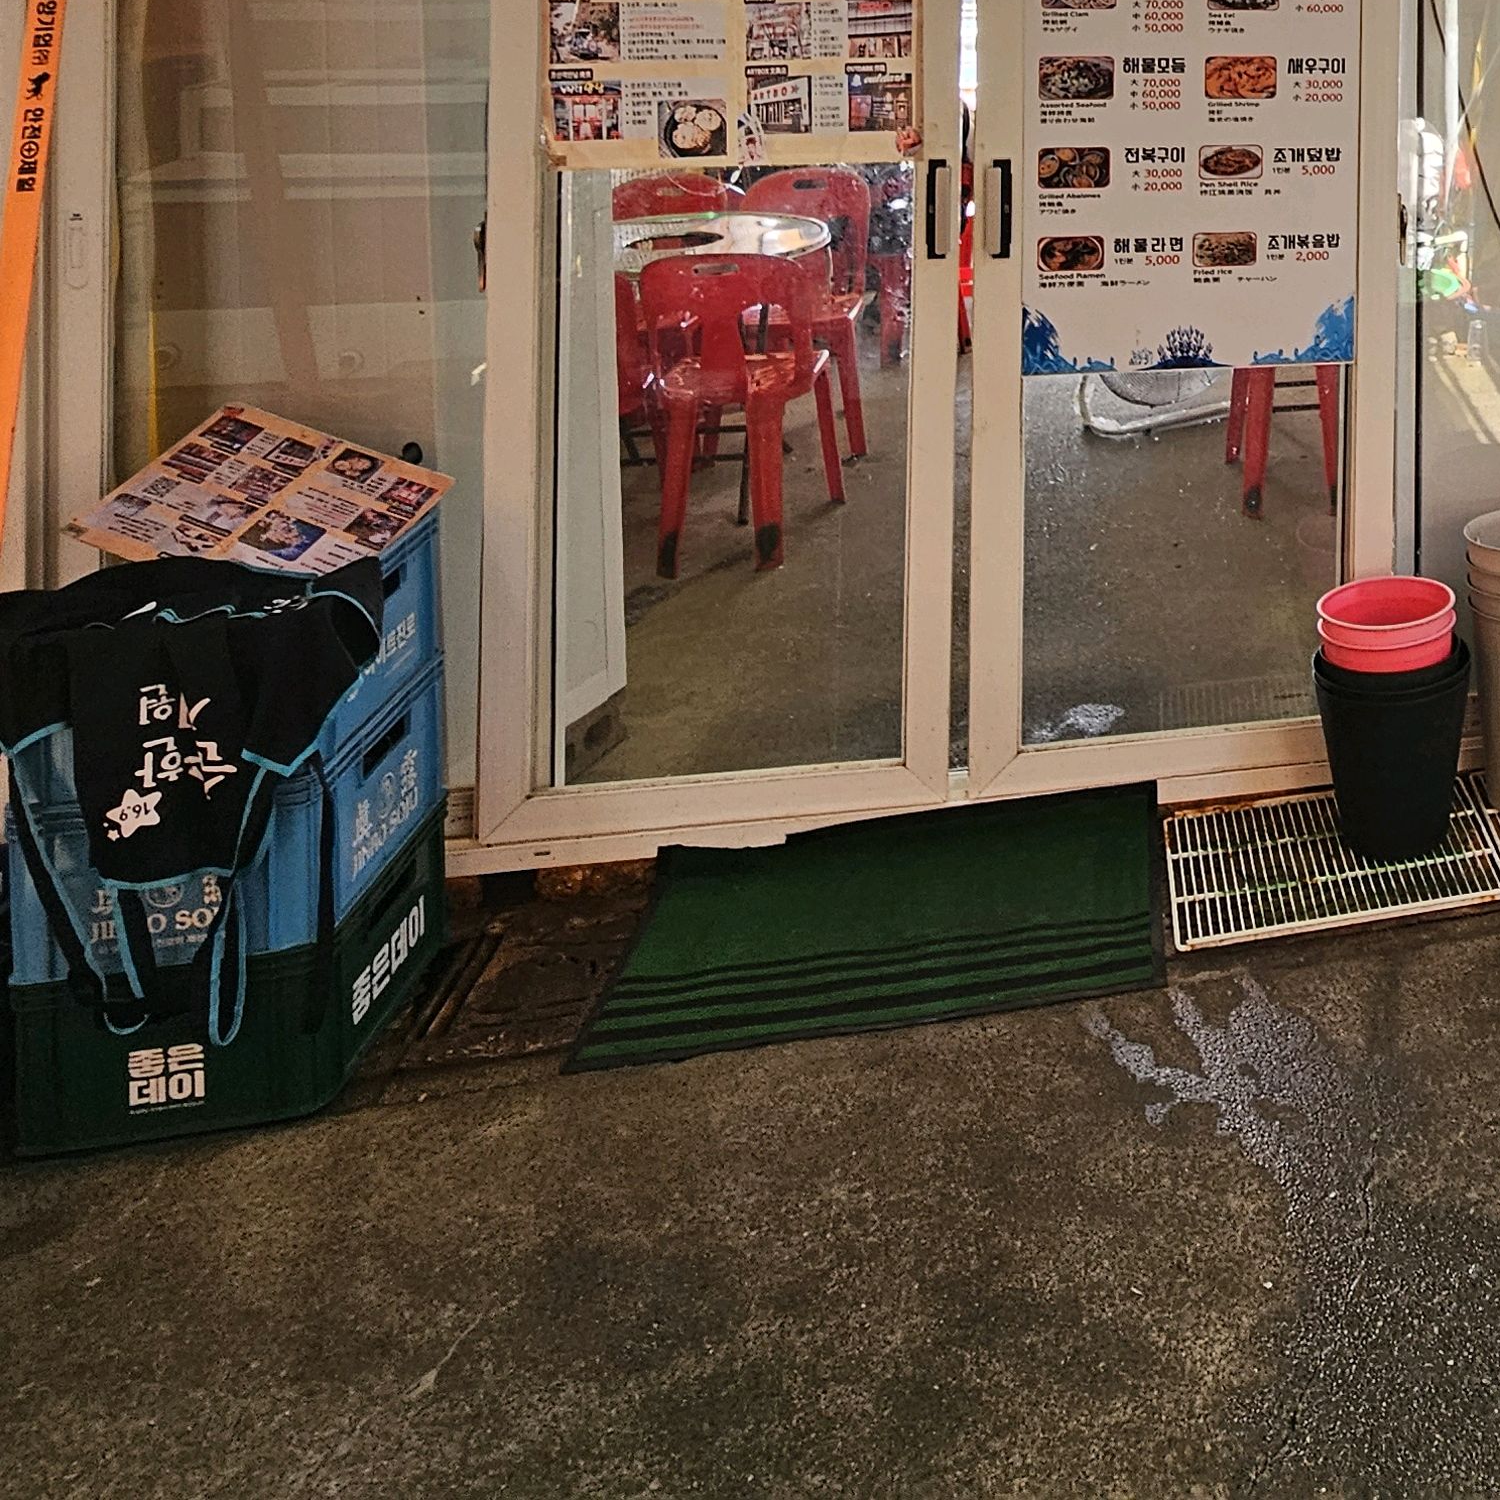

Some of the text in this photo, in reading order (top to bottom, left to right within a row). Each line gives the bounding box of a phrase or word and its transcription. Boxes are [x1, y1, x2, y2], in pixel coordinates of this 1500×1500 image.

[1145, 0, 1183, 10] 70,000
[1306, 4, 1344, 14] 60,000
[1144, 11, 1183, 21] 60,000
[1144, 23, 1183, 33] 50,000
[1123, 57, 1186, 74] 해물모듬
[1287, 58, 1346, 74] 새우구이
[1143, 79, 1181, 88] 70,000
[1305, 80, 1343, 90] 30,000
[1142, 89, 1181, 99] 60,000
[1305, 93, 1343, 102] 20,000
[1142, 101, 1181, 111] 50,000
[1125, 147, 1185, 163] 전복구이
[1145, 169, 1182, 179] 30,000
[1302, 165, 1336, 176] 5,000
[1144, 182, 1182, 191] 20,000
[1114, 237, 1183, 253] 해물라면
[1268, 234, 1340, 250] 조개볶음밥
[1145, 255, 1180, 266] 5,000
[1296, 251, 1330, 262] 2,000
[134, 736, 238, 800] 순한
[119, 802, 152, 821] 16.9
[351, 894, 425, 1025] 좋은데이
[127, 1042, 205, 1078] 좋은
[128, 1069, 206, 1107] 데이
